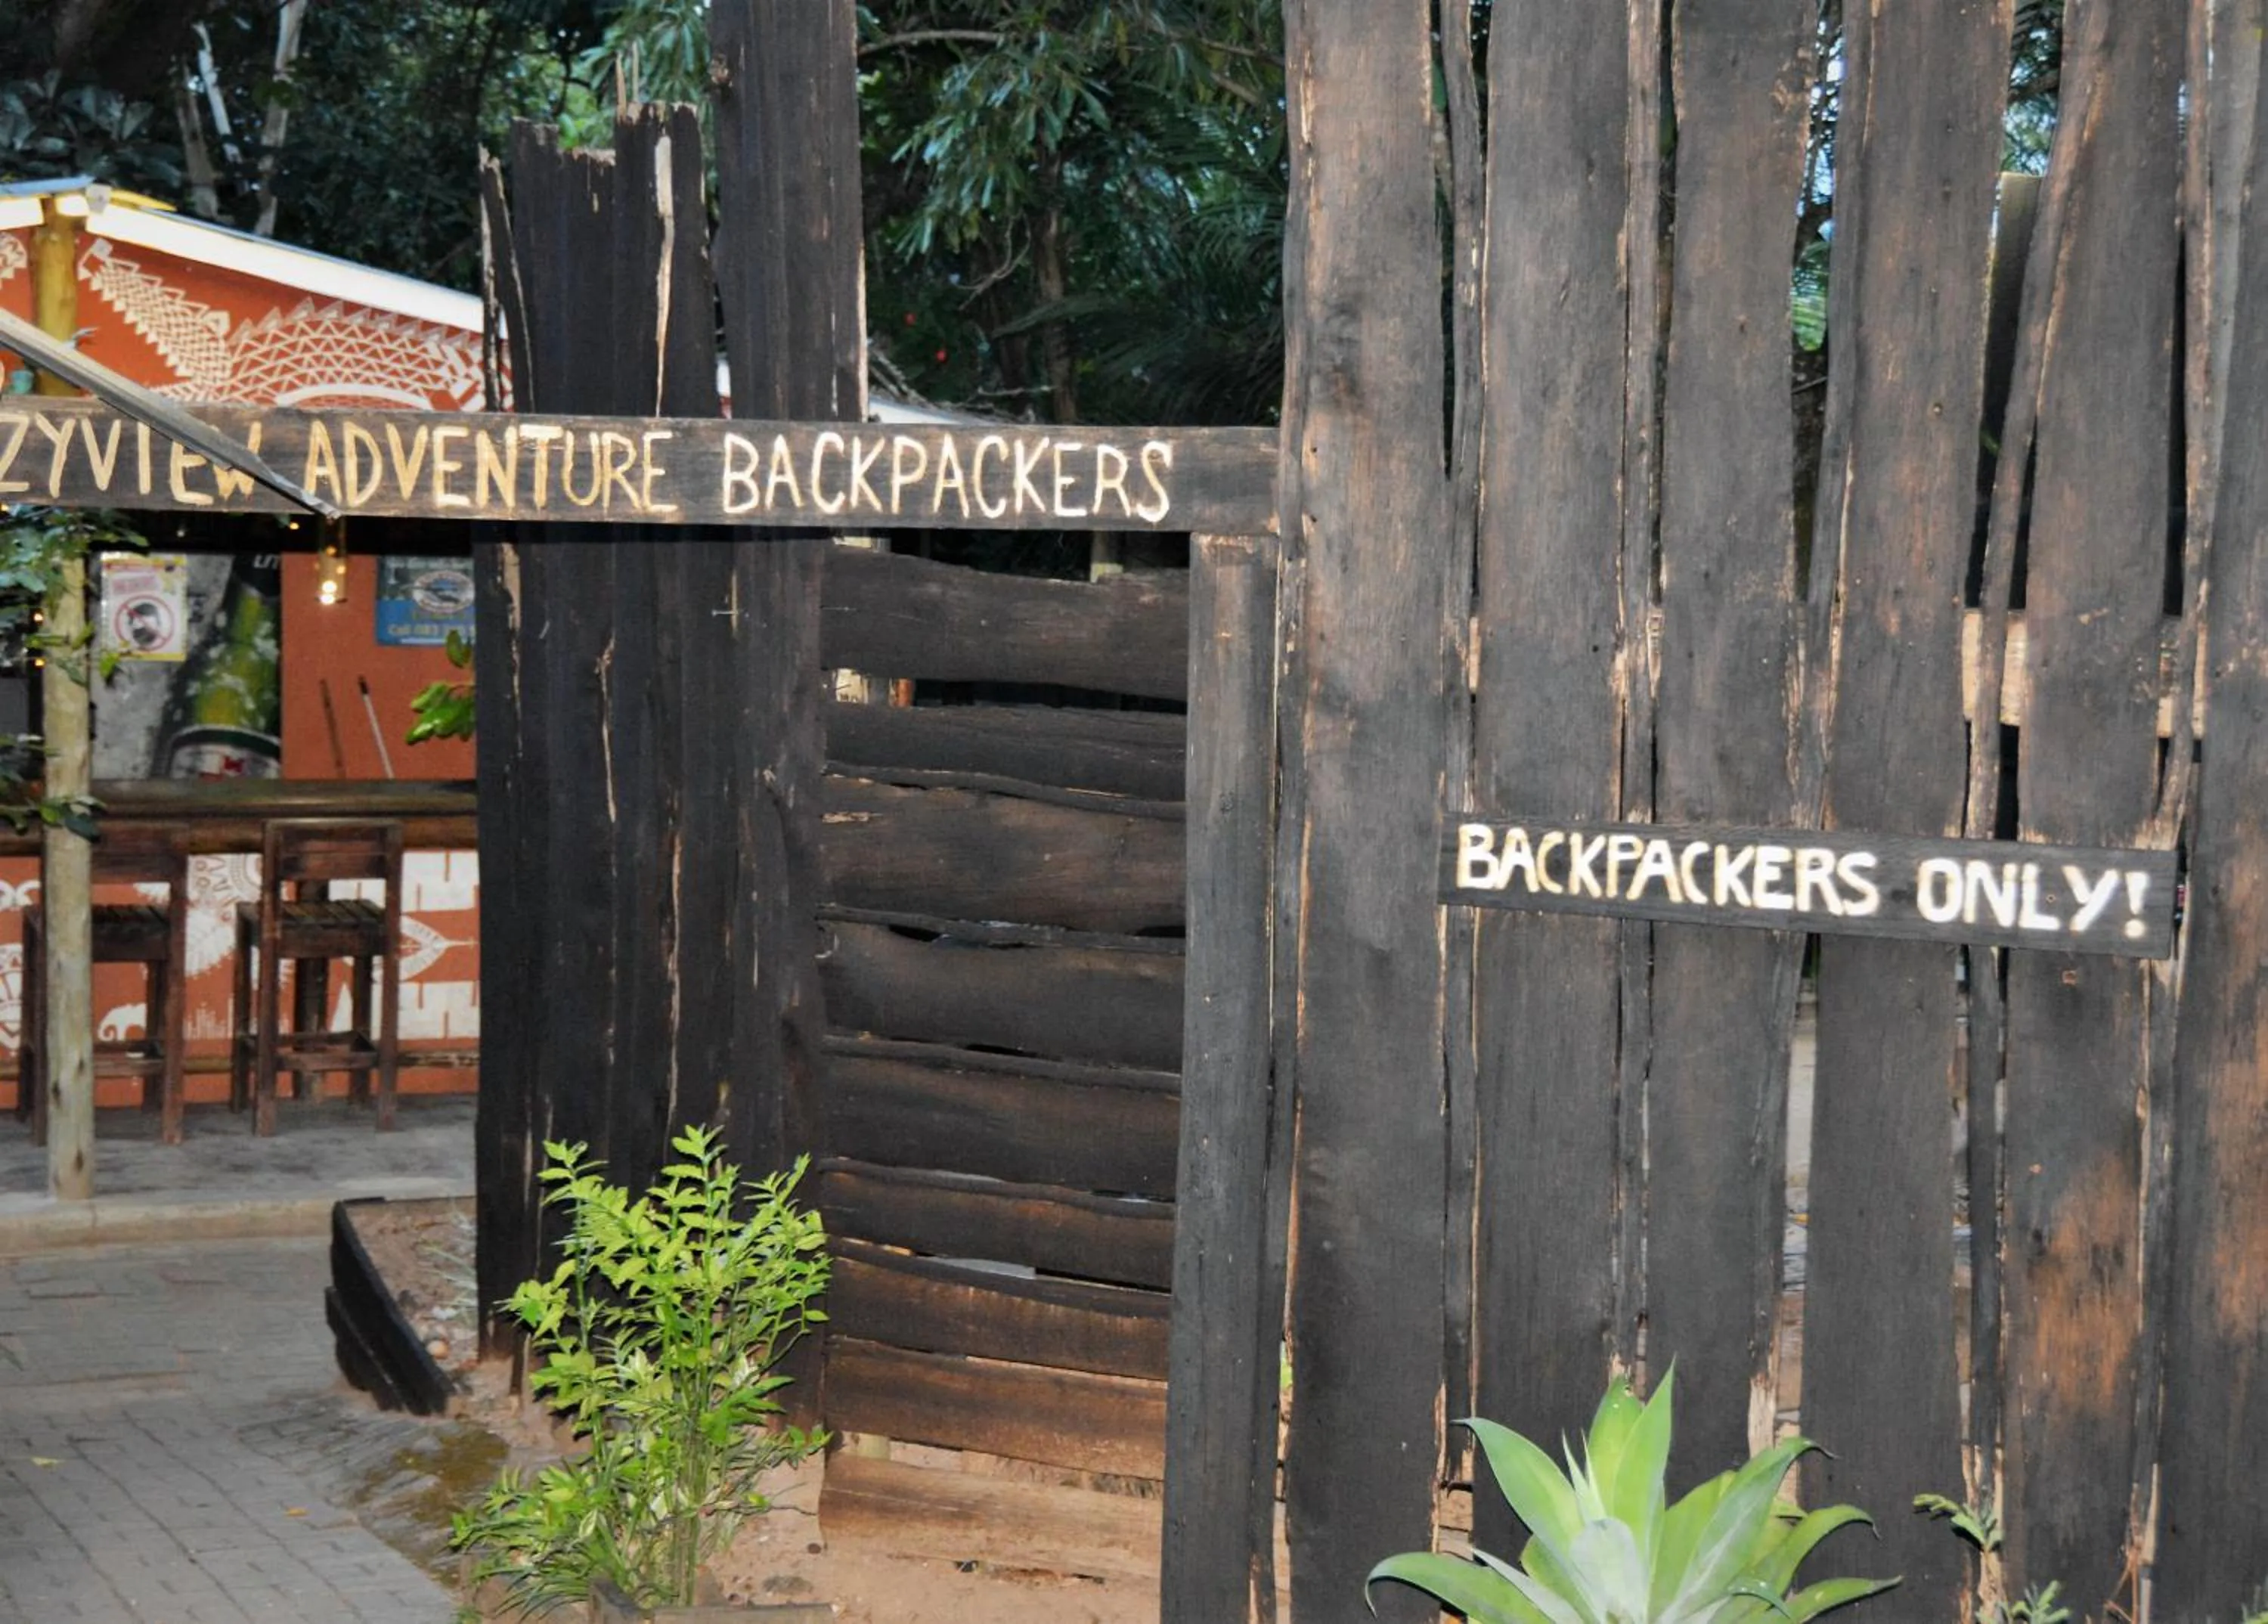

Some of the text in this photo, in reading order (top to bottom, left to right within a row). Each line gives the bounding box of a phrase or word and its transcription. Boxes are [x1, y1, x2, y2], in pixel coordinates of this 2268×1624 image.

[304, 419, 677, 513] ADVENTURE
[722, 431, 1172, 523] BACKPACKERS
[1455, 823, 2152, 938] BACKPACKERS ONLY!
